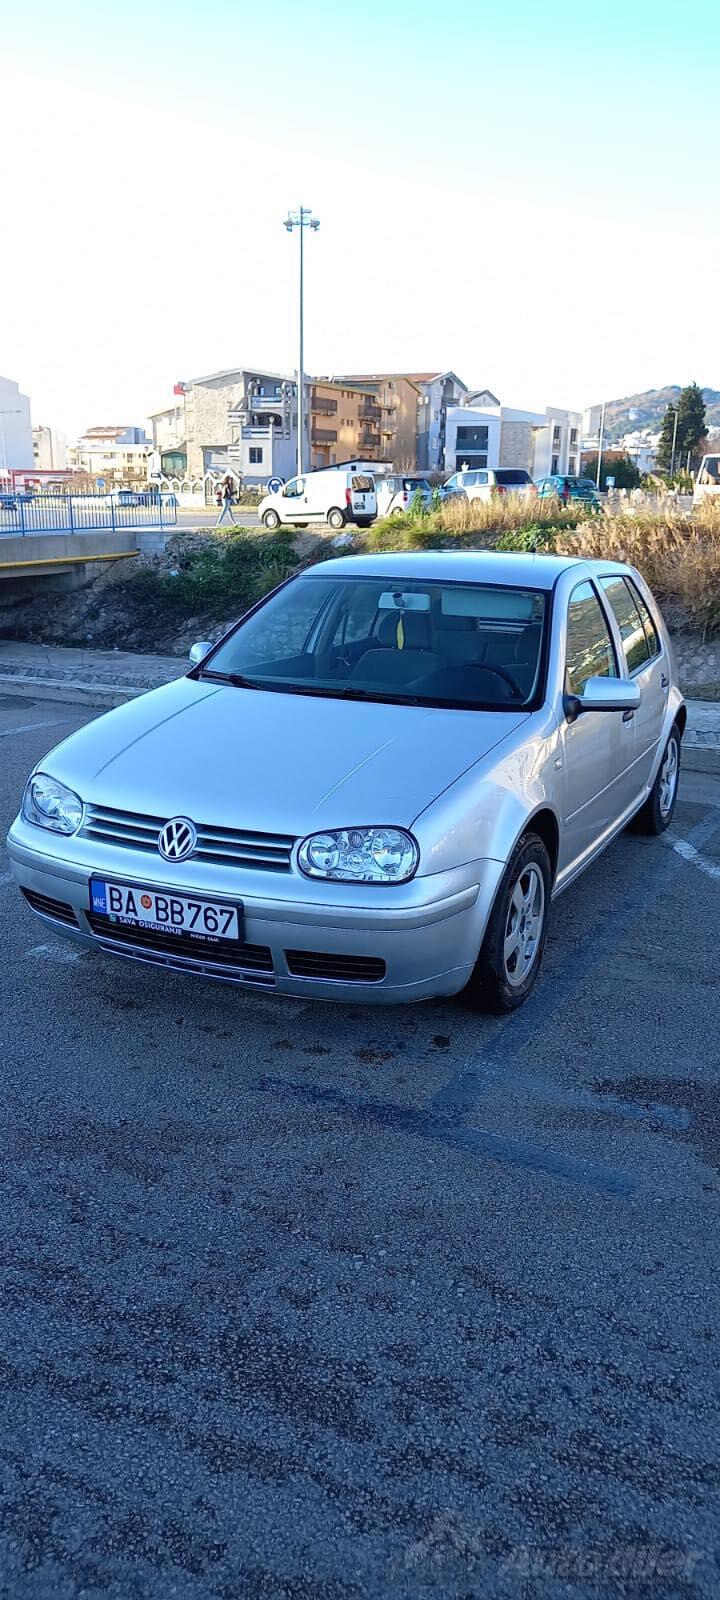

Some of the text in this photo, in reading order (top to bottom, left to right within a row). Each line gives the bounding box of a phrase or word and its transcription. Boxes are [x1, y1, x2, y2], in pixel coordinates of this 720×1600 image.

[109, 886, 234, 934] BA BB767
[119, 916, 182, 935] SAVA OSIGURANJE
